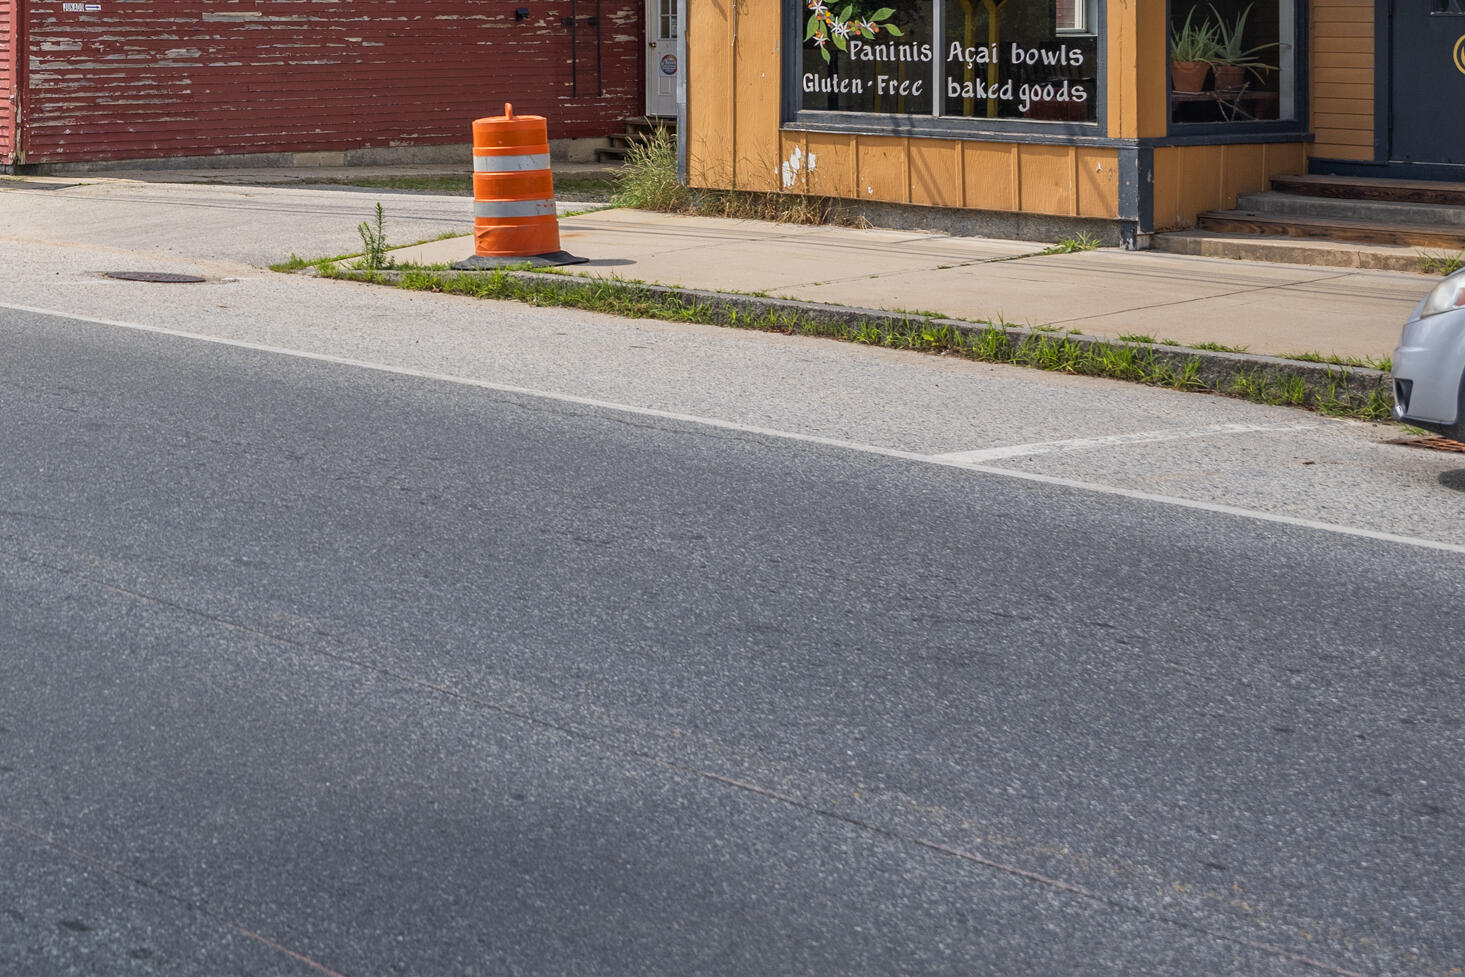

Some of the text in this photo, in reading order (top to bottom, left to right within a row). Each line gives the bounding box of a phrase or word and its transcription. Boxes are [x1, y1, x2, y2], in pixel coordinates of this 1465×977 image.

[849, 41, 1085, 69] Paninis Açai bowls
[947, 77, 1014, 100] baked
[1018, 81, 1088, 112] goods
